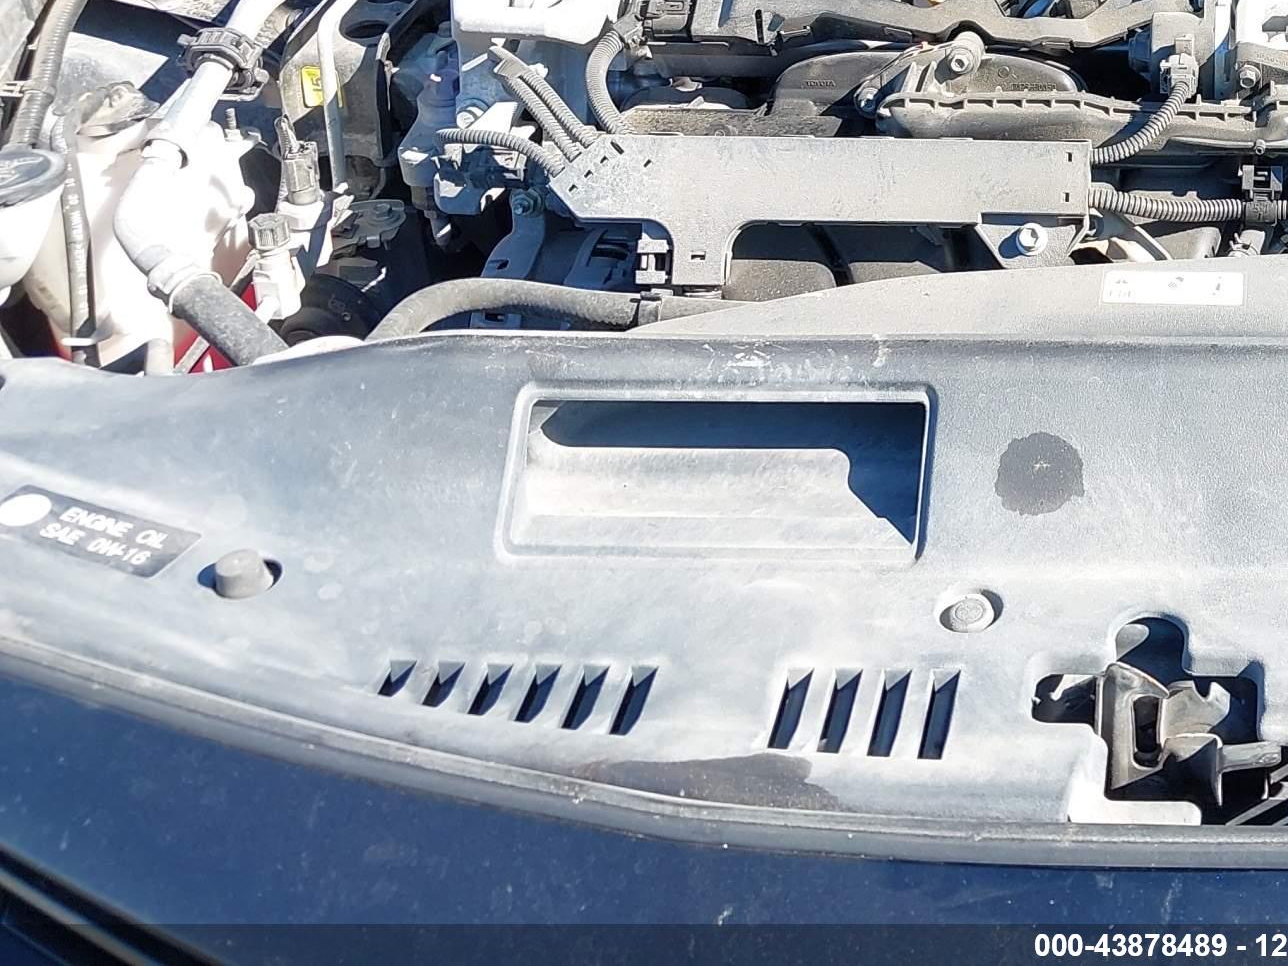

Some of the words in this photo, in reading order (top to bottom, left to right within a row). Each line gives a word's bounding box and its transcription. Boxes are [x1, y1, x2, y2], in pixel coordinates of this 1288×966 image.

[39, 522, 86, 546] SAE
[59, 506, 134, 538] ENGINE
[135, 529, 169, 550] OIL
